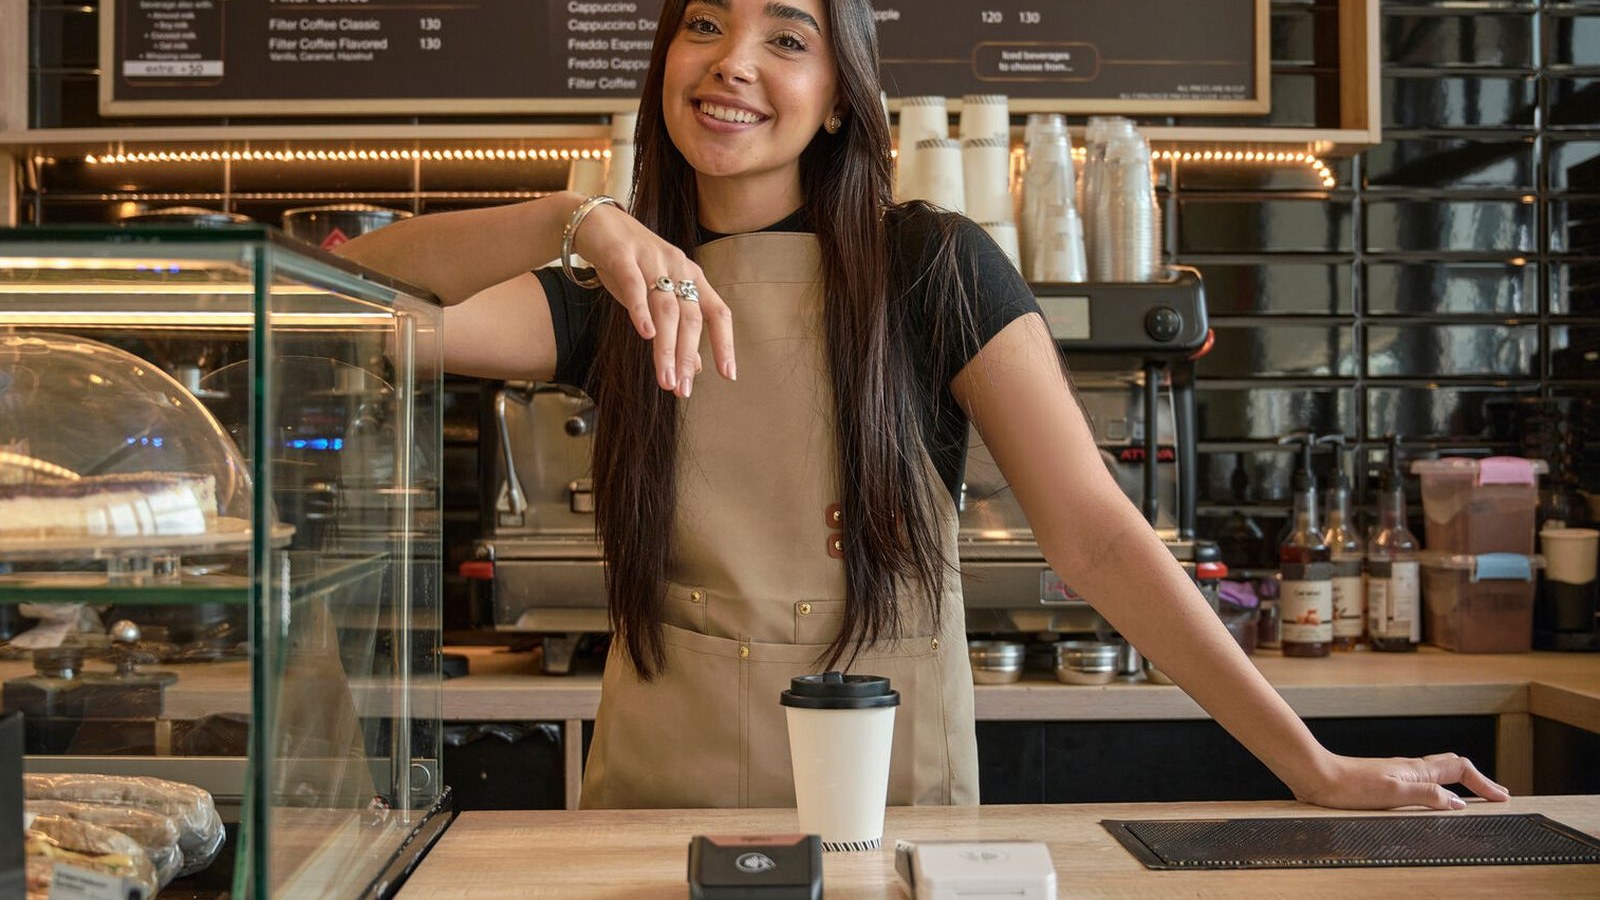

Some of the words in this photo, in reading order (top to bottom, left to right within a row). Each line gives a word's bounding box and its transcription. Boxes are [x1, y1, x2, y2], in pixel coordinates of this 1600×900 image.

[568, 1, 637, 14] Cappuccino
[981, 11, 1002, 23] 120
[1019, 11, 1041, 23] 130
[269, 18, 297, 30] Filter
[299, 18, 337, 30] Coffee
[339, 18, 380, 30] Classic
[420, 18, 441, 30] 130
[568, 19, 637, 32] Cappuccino
[269, 38, 297, 50] Filter
[299, 38, 337, 50] Coffee
[339, 38, 388, 50] Flavored
[420, 38, 441, 50] 130
[568, 38, 609, 50] Freddo
[1002, 51, 1022, 61] Iced
[1023, 51, 1070, 62] beverages
[568, 58, 609, 70] Freddo
[999, 63, 1009, 72] to
[1010, 62, 1043, 72] choose
[568, 77, 596, 89] Filter
[598, 77, 637, 89] Coffee
